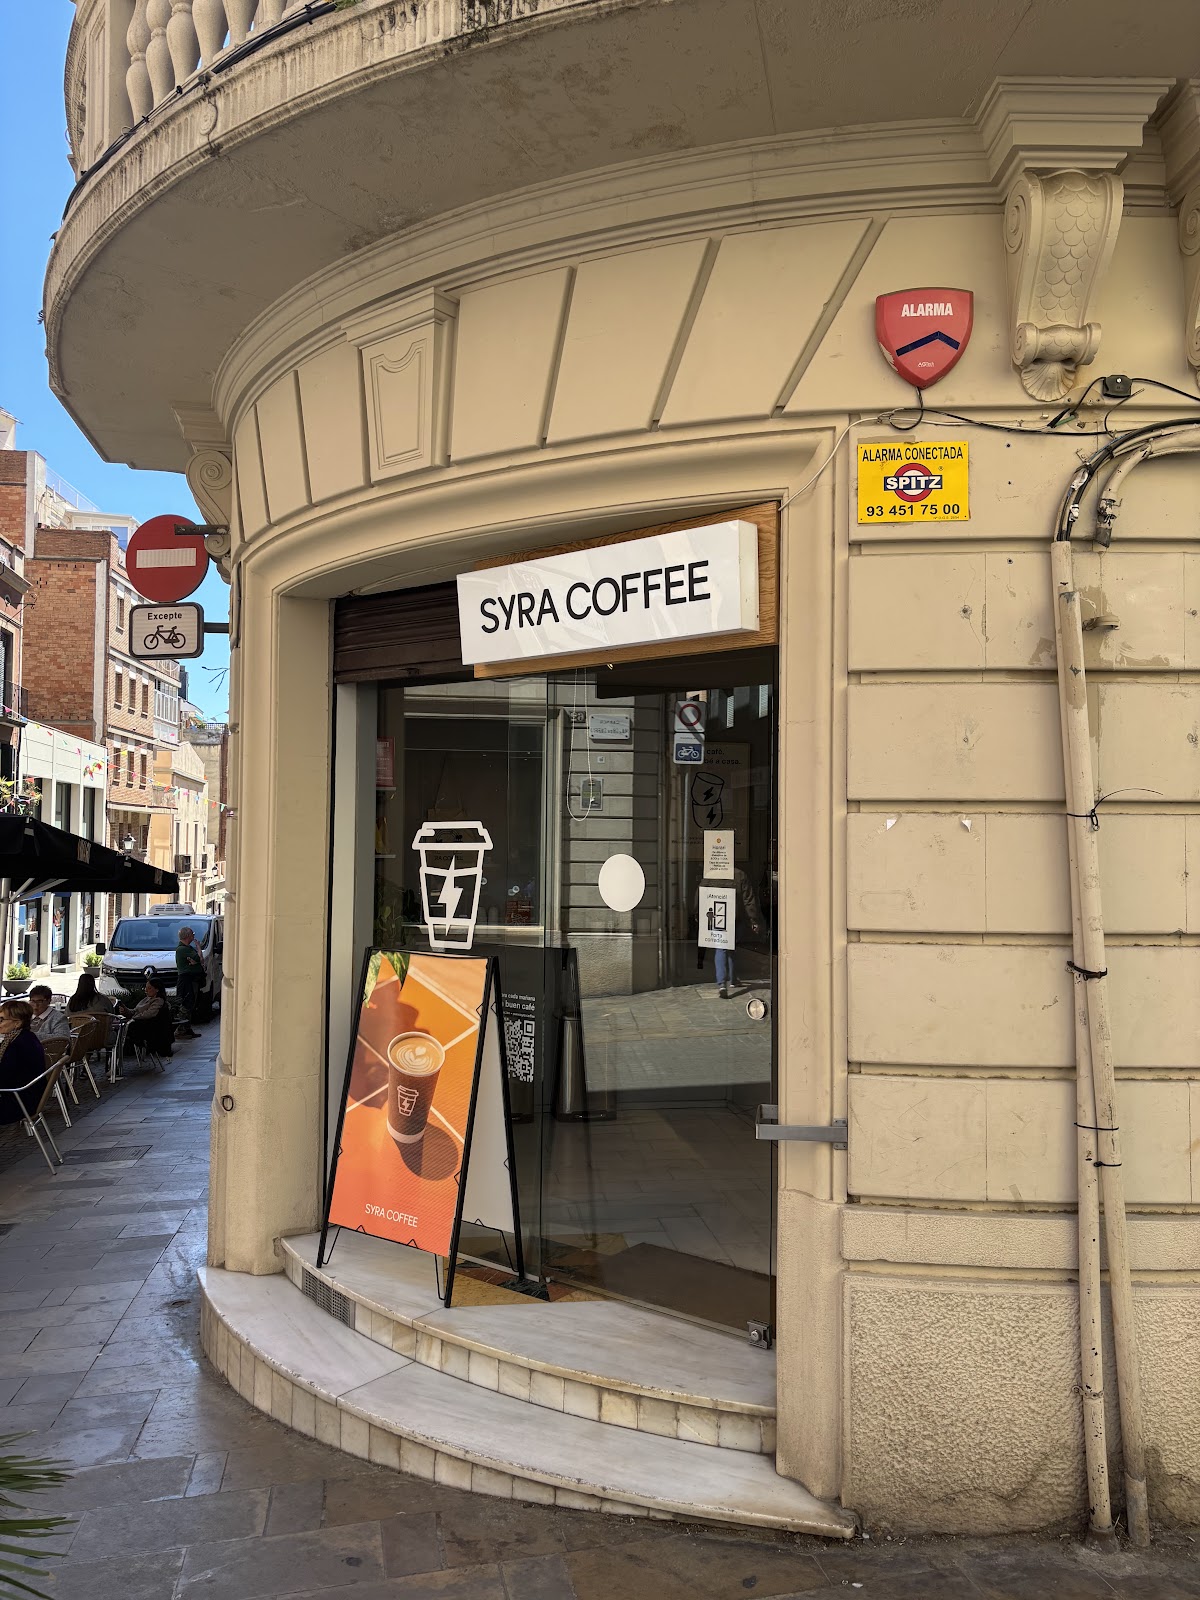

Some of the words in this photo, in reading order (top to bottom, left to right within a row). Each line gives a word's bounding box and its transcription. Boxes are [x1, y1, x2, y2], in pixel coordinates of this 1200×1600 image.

[901, 302, 954, 317] ALARMA
[862, 447, 903, 462] ALARMA
[904, 446, 964, 460] CONECTADA
[886, 476, 941, 490] SPITZ
[866, 505, 884, 517] 93
[889, 504, 914, 516] 451
[920, 504, 938, 515] 75
[943, 503, 960, 515] 00
[480, 588, 560, 634] SYRA
[565, 559, 711, 621] COFFEE
[147, 612, 183, 621] Excepte
[505, 1000, 521, 1009] buen
[521, 1003, 536, 1011] café
[364, 1203, 386, 1219] SYRA
[386, 1209, 419, 1228] COFFEE
